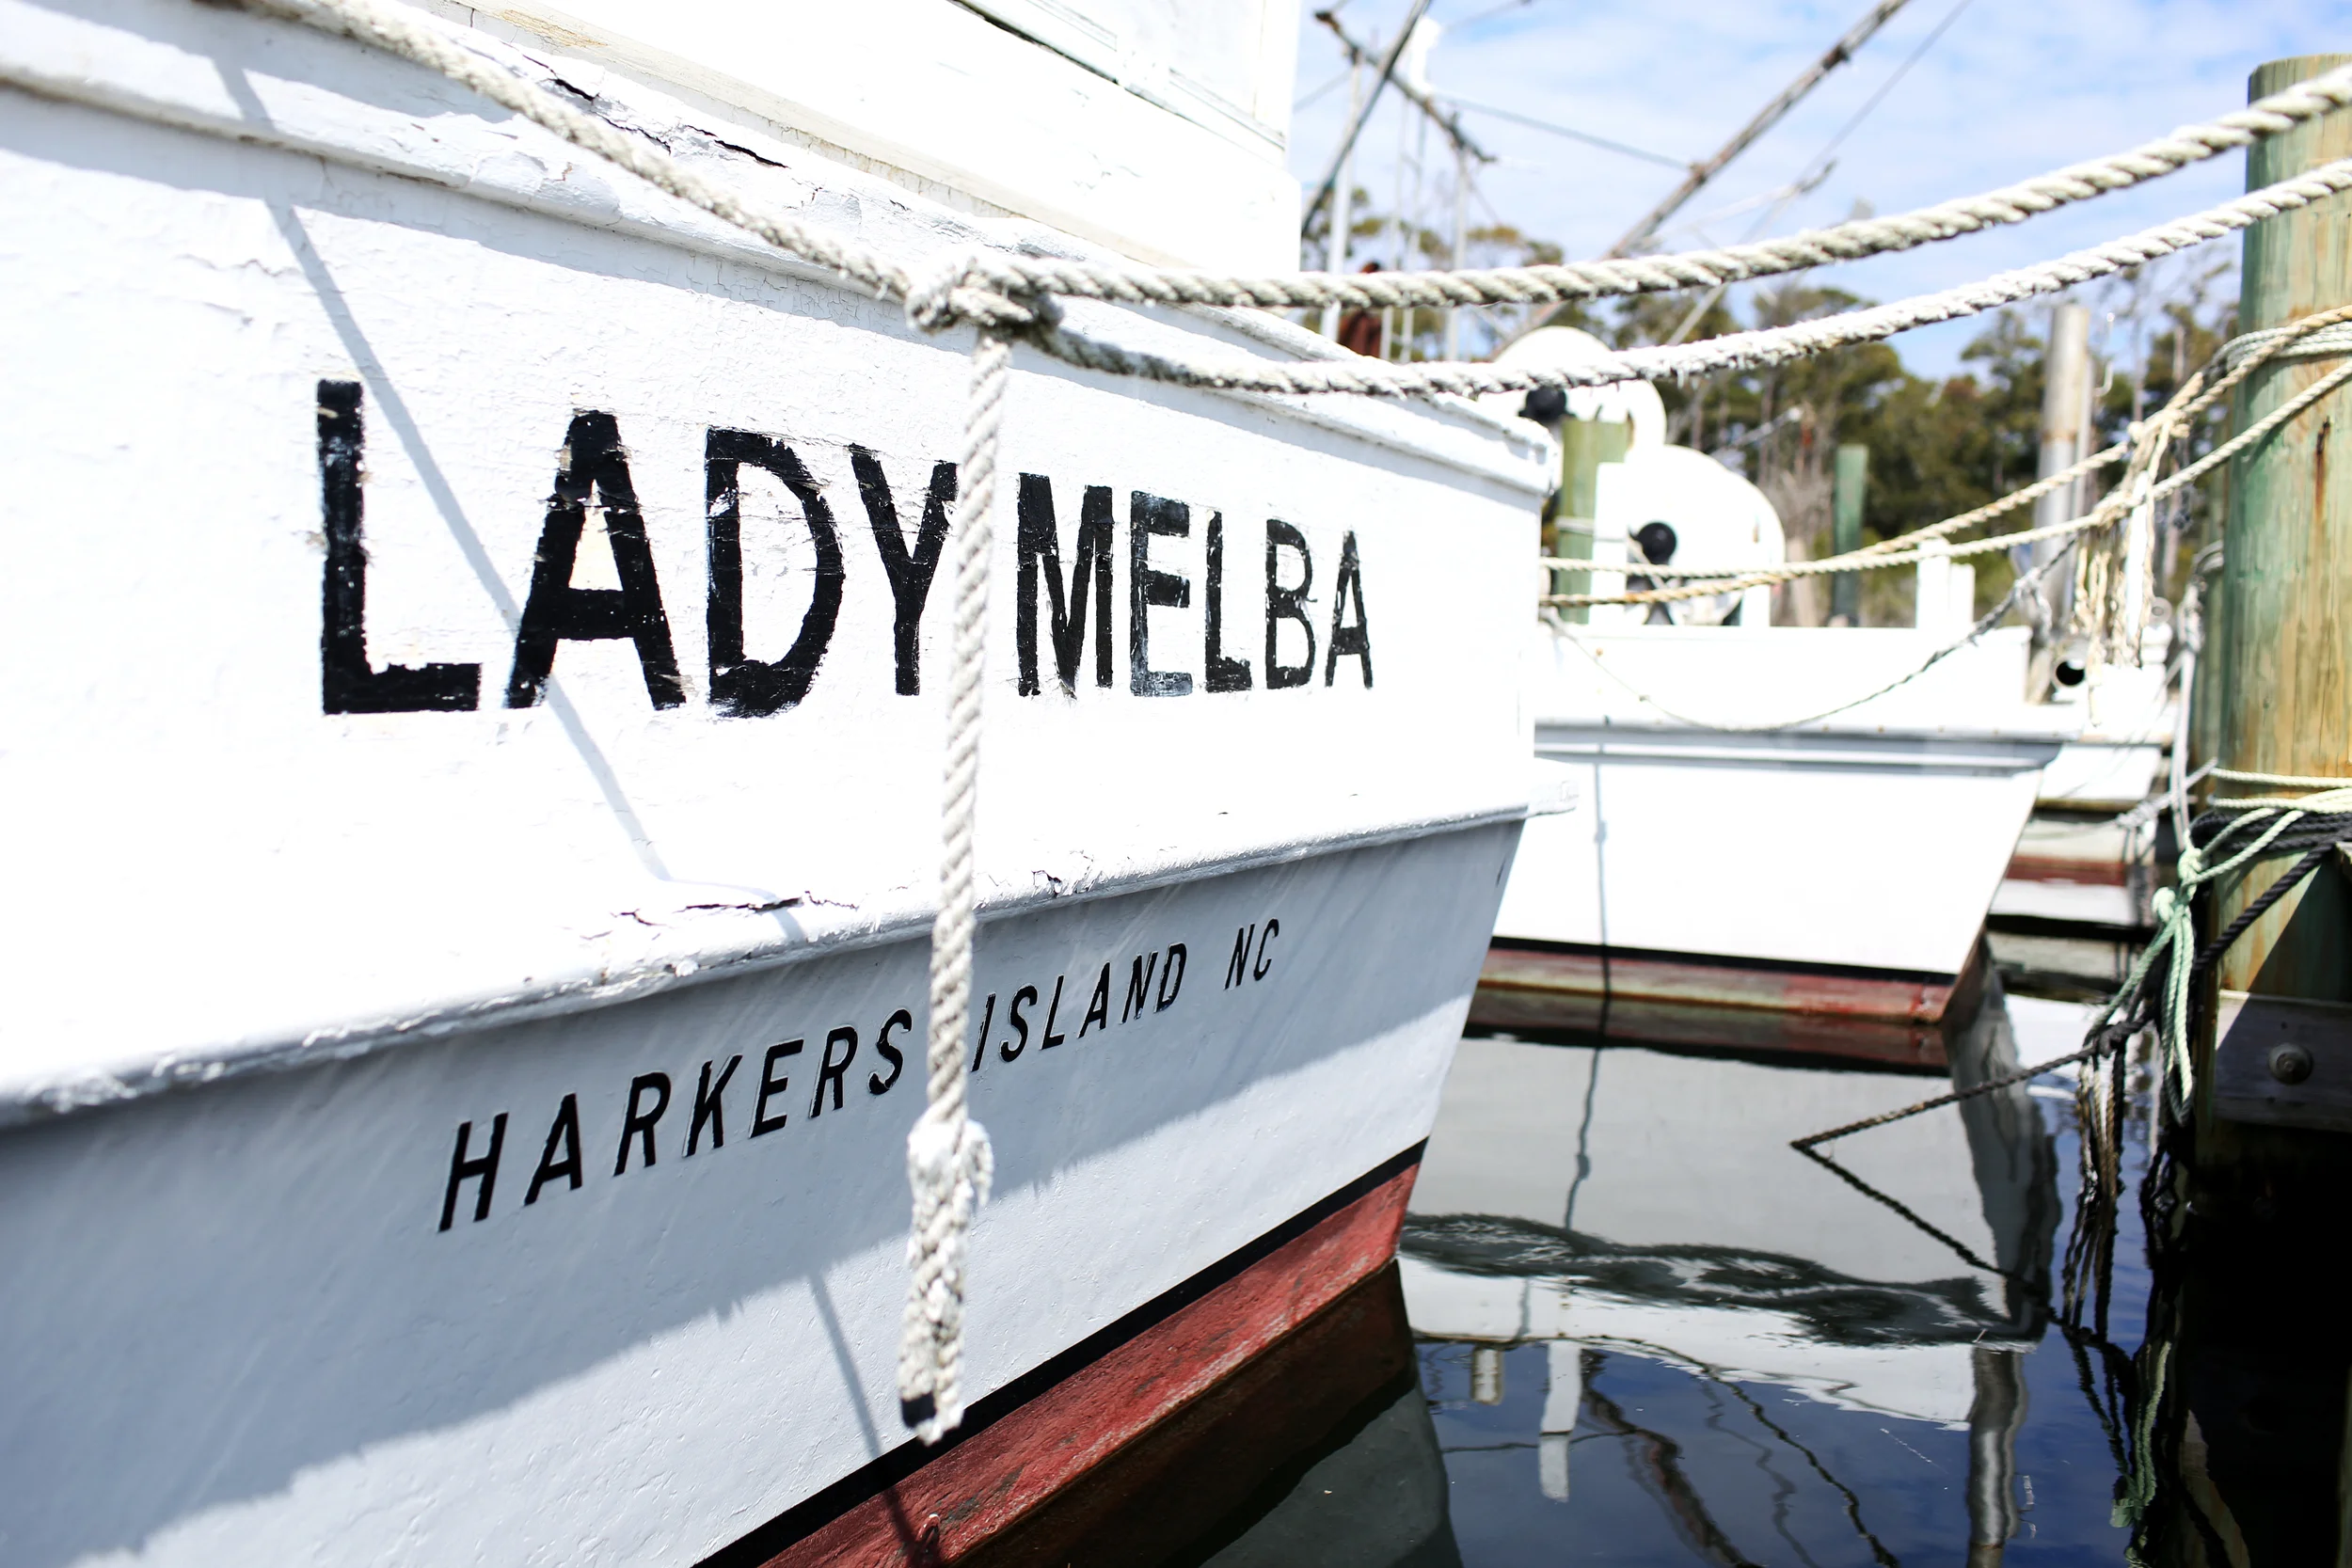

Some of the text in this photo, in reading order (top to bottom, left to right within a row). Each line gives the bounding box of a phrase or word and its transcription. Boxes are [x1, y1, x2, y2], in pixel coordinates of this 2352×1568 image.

[317, 378, 1373, 718] LADY MELBA
[437, 918, 1279, 1232] HARKERS ISLAND NC
